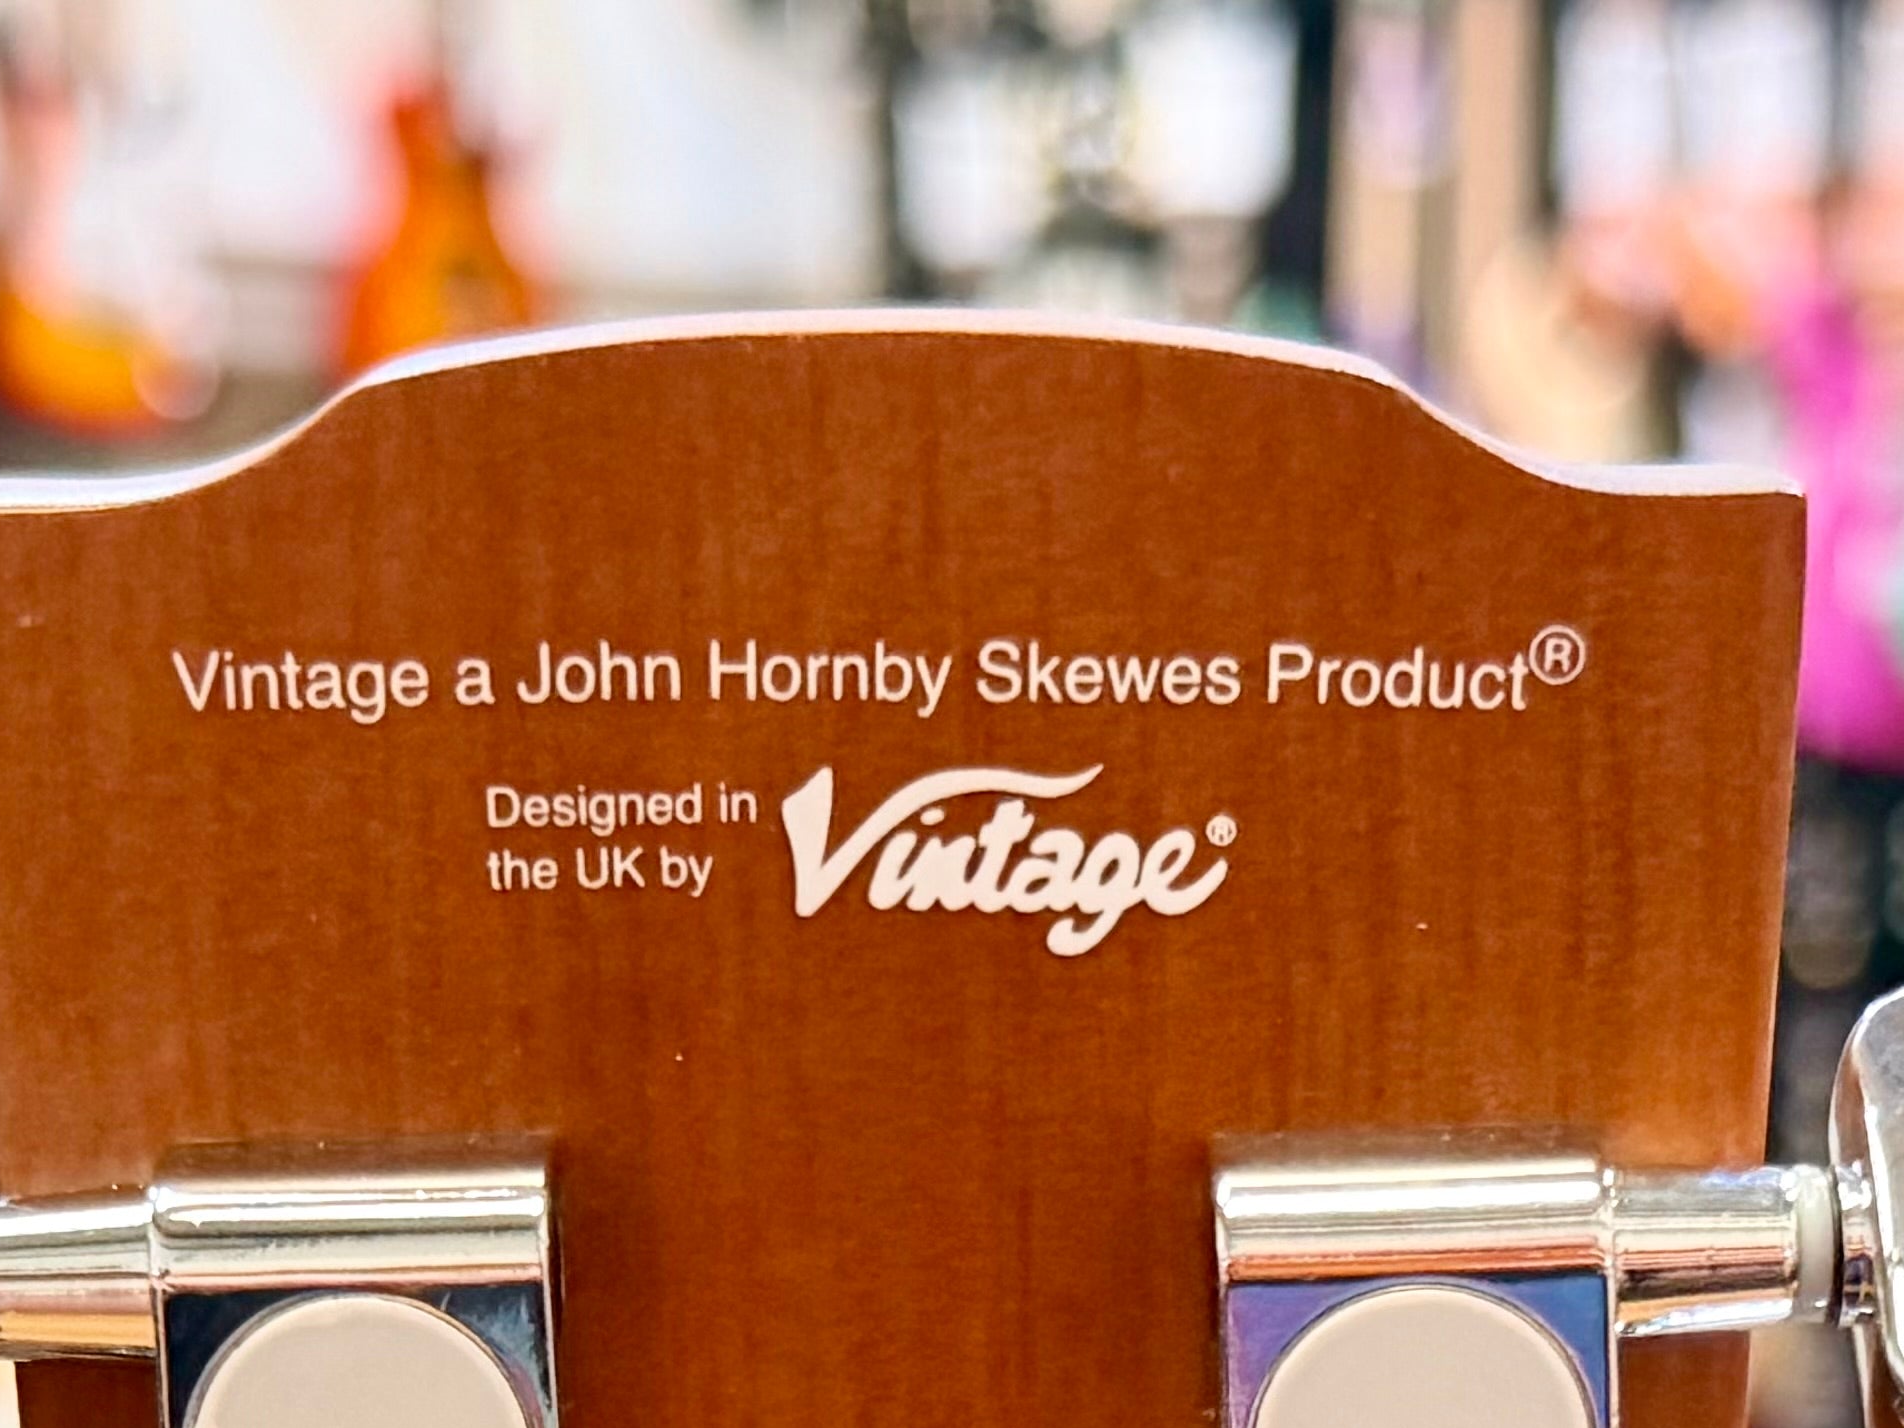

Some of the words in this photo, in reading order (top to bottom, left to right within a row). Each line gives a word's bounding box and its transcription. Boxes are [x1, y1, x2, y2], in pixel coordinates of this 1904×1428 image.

[171, 645, 430, 725] Vintage
[454, 657, 496, 706] a
[516, 639, 682, 704] John
[708, 638, 954, 719] Hornby
[975, 638, 1242, 706] Skewes
[485, 782, 703, 838] Designed
[718, 782, 758, 825] in
[486, 848, 559, 891] the
[575, 845, 646, 890] UK
[659, 845, 714, 898] by
